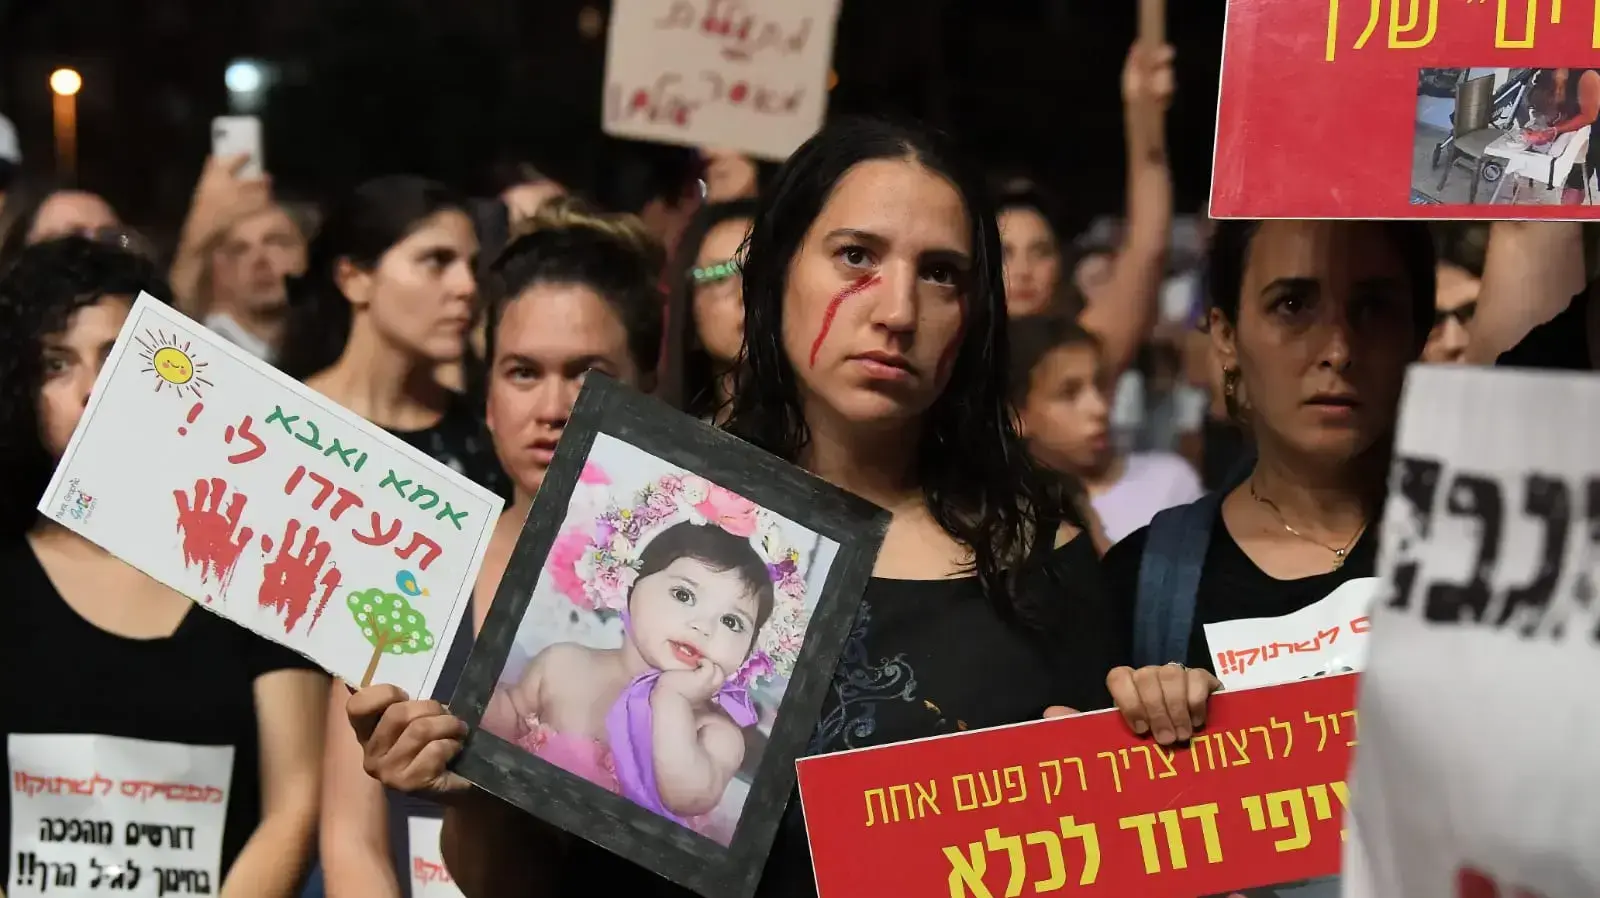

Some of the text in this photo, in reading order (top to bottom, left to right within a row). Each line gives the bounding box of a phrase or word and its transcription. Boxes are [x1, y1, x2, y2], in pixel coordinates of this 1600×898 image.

[224, 415, 266, 464] לי
[266, 405, 469, 531] אמא ואבא
[285, 466, 443, 570] תעזרו
[1217, 625, 1341, 676] לשתוק!!
[1096, 743, 1179, 793] צריך
[1189, 716, 1293, 773] לרצוח
[864, 779, 941, 827] אחת
[952, 765, 1027, 812] פעם
[1040, 755, 1088, 804] רק
[39, 817, 114, 846] מהפכה
[941, 815, 1101, 898] לכלא
[1118, 802, 1223, 875] דוד
[90, 858, 141, 890] לגל
